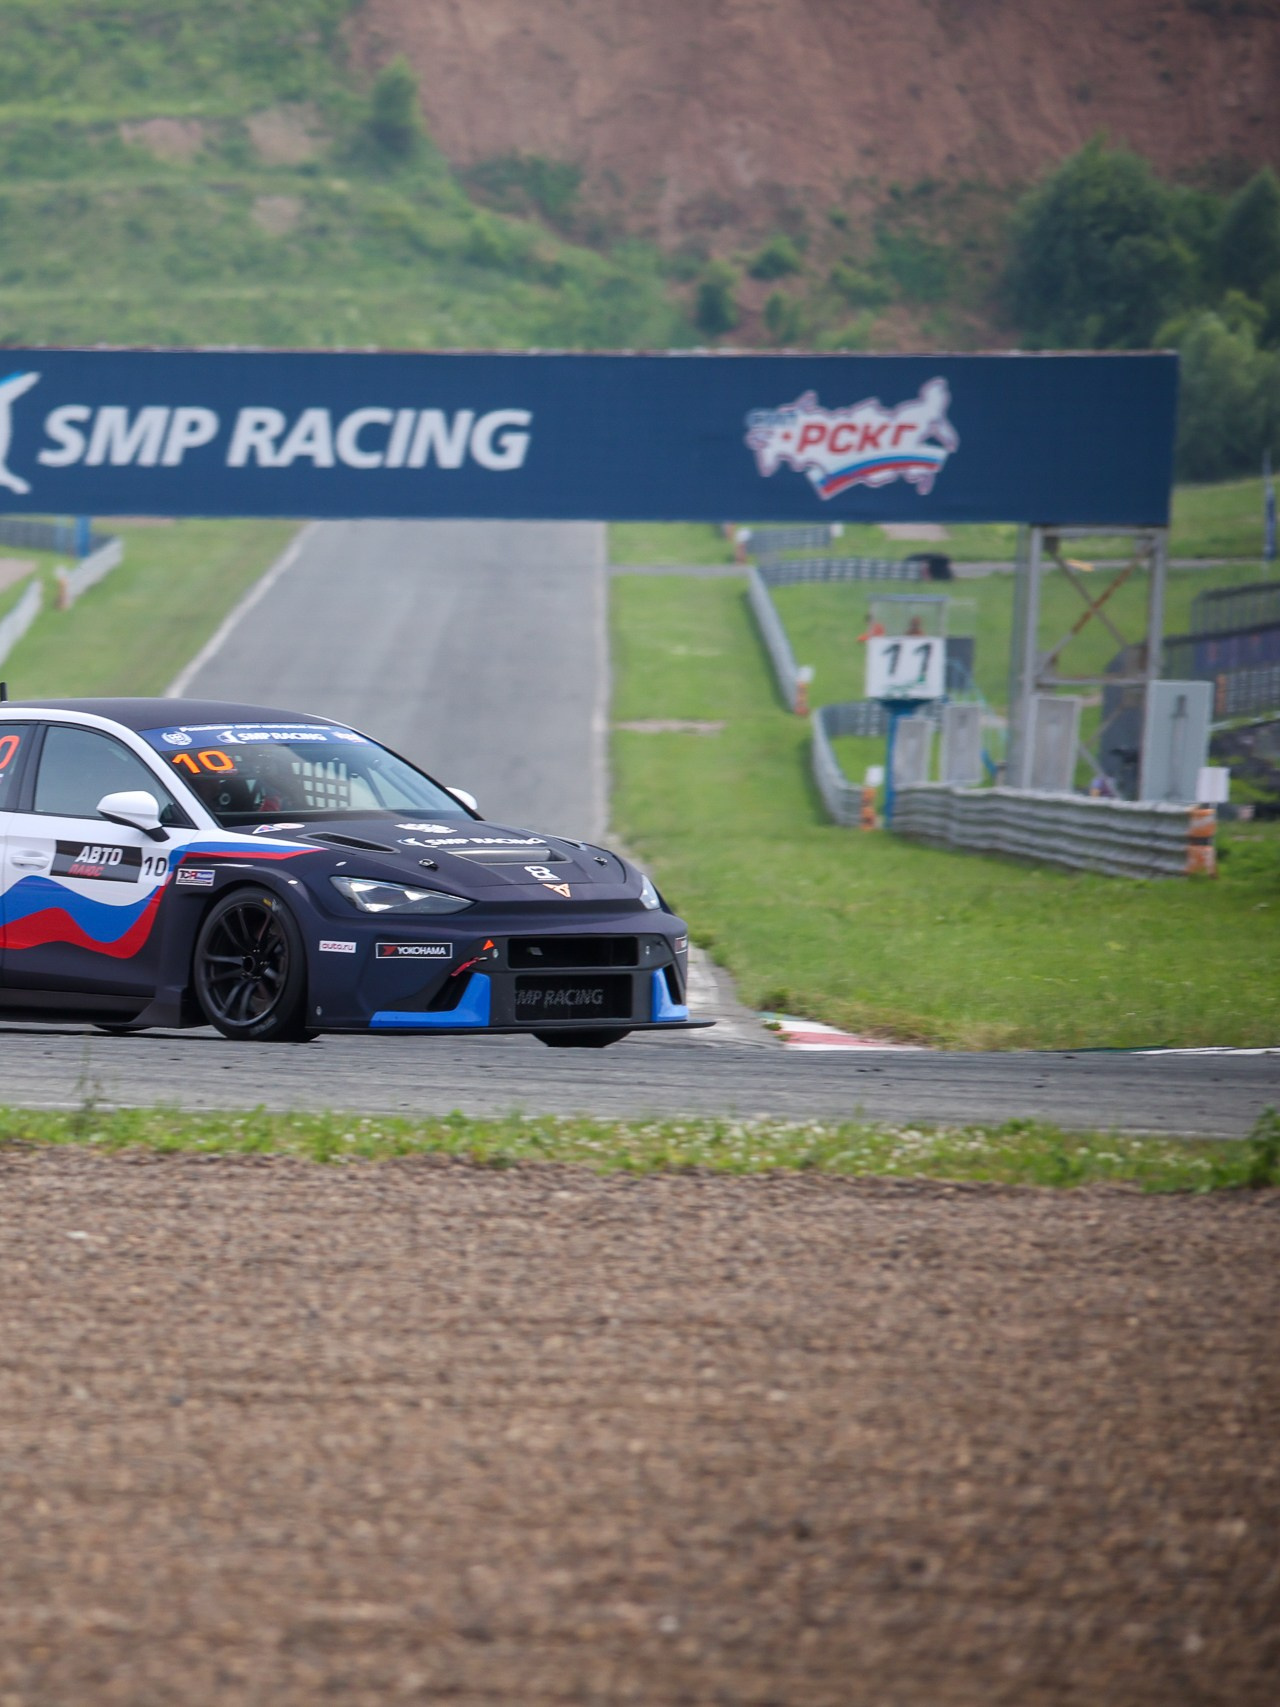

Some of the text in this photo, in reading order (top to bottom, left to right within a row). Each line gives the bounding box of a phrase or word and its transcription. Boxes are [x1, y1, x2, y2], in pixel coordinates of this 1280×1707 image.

[38, 404, 533, 472] SMP RACING
[795, 423, 920, 455] РСКГ
[881, 642, 933, 683] 11
[236, 731, 271, 742] SMP
[270, 732, 329, 742] RACING
[172, 750, 234, 775] 10
[74, 845, 123, 866] АВТО
[67, 864, 106, 878] ПЛЮС
[144, 856, 168, 877] 10
[321, 943, 354, 952] auto.ru
[396, 946, 447, 956] YOKOHAMA
[515, 988, 604, 1008] MP RACING
